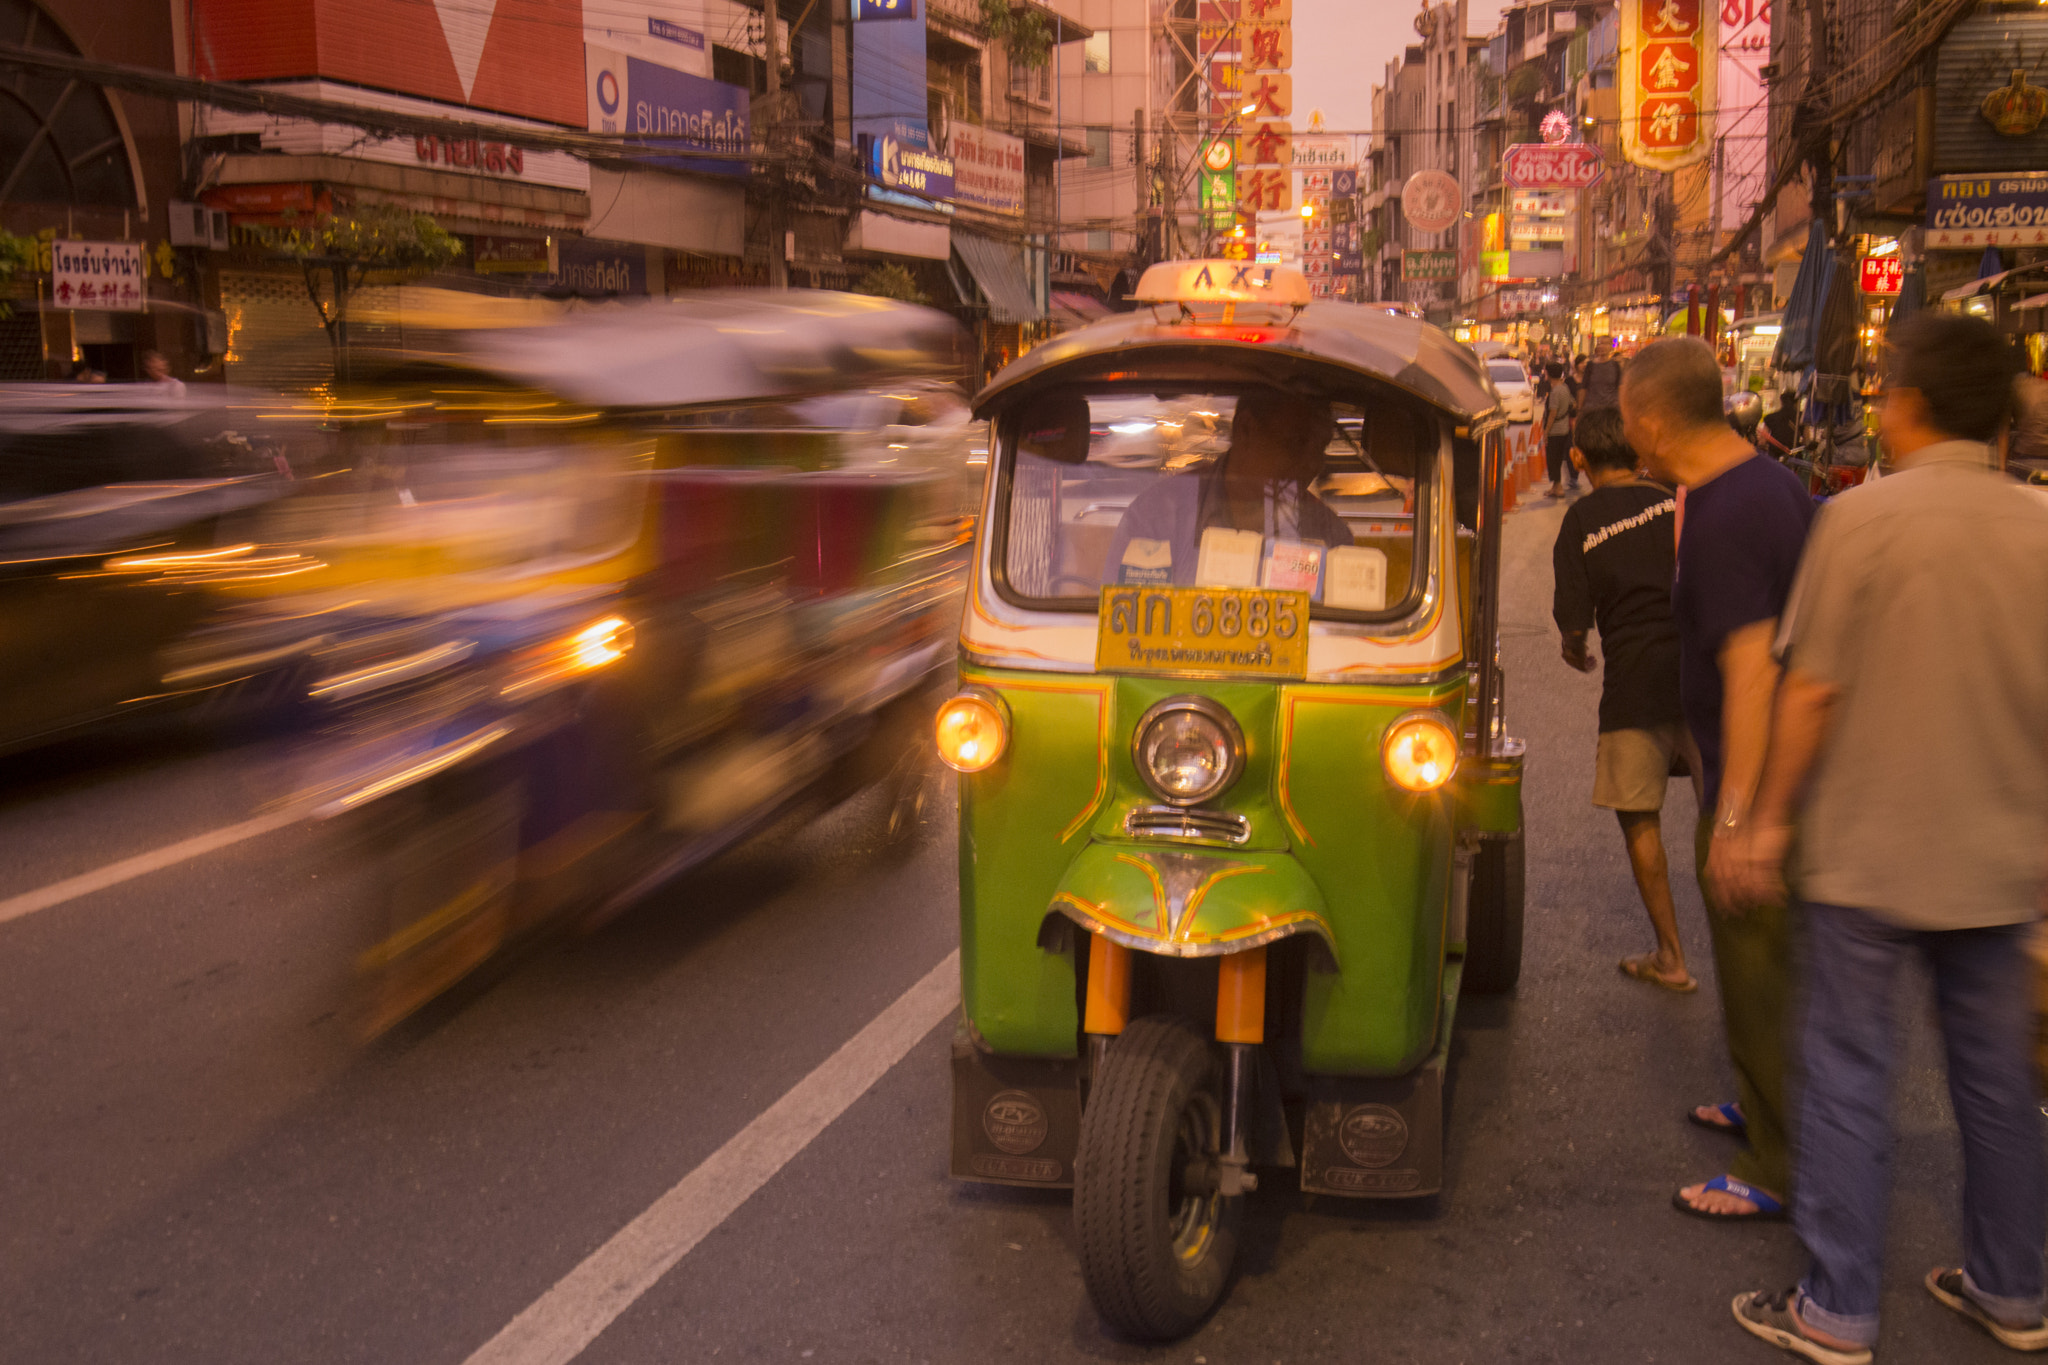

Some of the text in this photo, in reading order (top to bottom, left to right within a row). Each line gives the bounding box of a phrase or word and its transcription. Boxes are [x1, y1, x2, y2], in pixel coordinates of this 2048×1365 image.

[1998, 179, 2048, 195] ตรามง
[55, 245, 140, 277] โรงรับจำนำ
[1192, 264, 1274, 289] AXI
[1111, 591, 1298, 639] สก 6885
